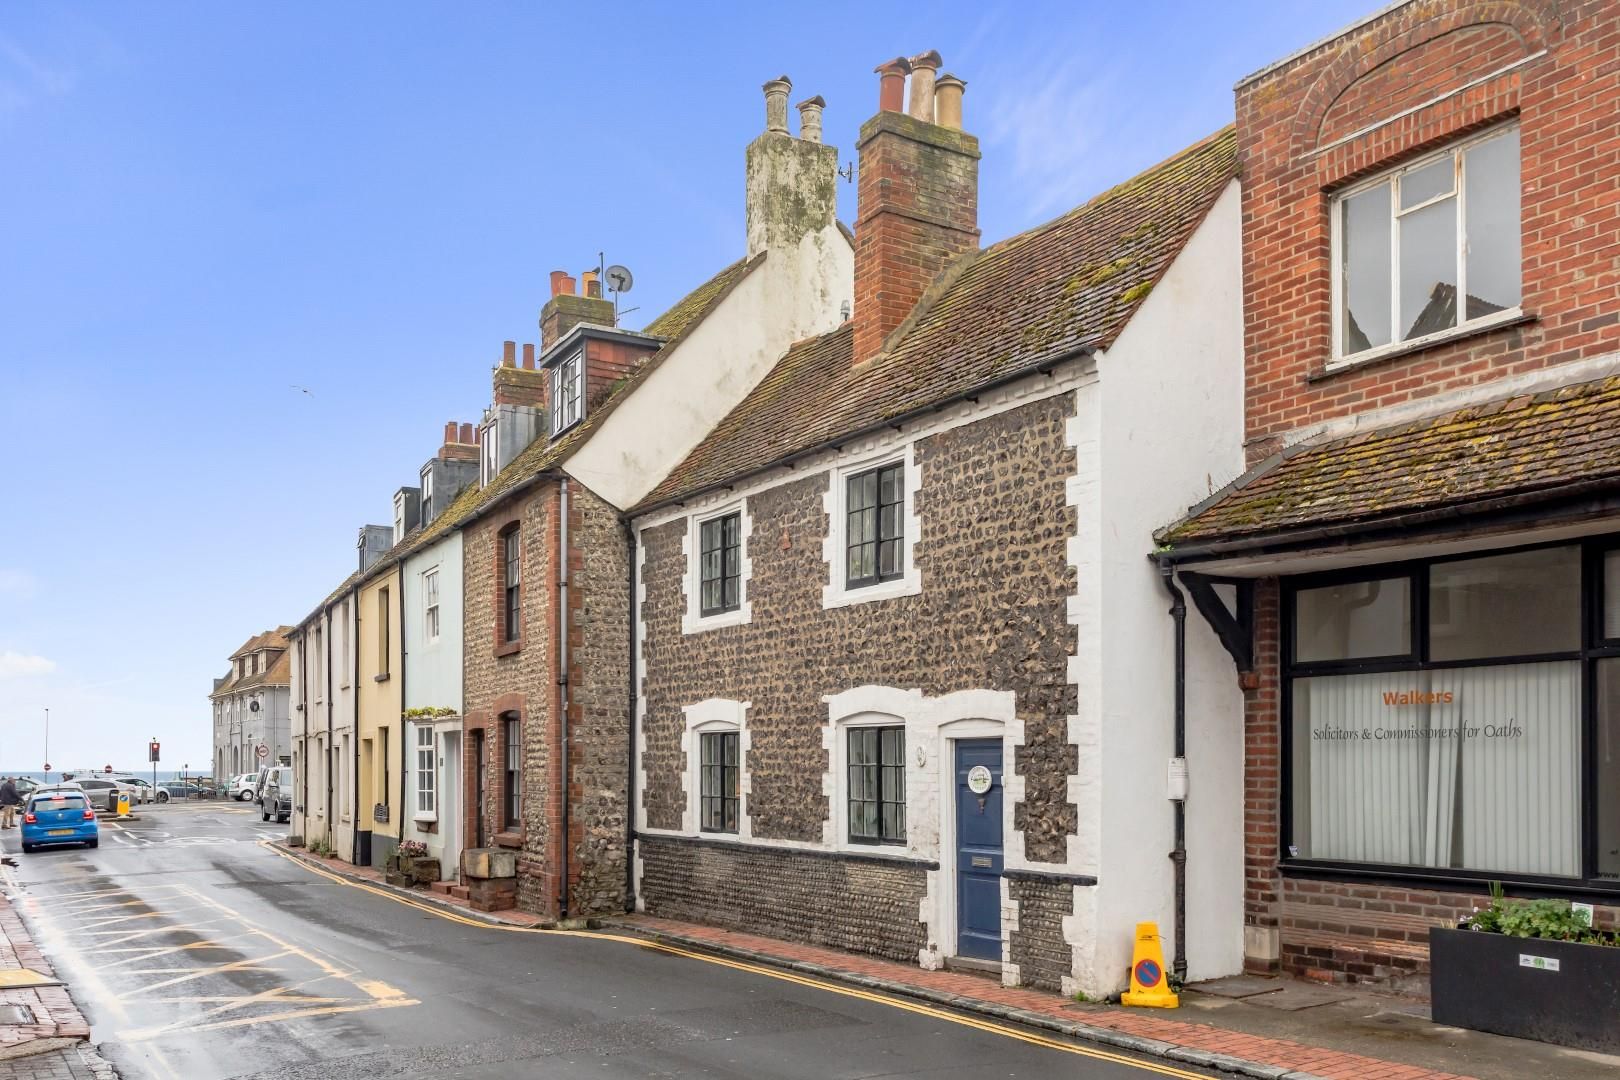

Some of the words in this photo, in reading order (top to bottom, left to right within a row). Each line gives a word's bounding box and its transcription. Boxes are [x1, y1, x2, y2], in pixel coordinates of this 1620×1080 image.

[1383, 690, 1453, 705] Walkers
[1313, 723, 1359, 740] Solicitors
[1361, 728, 1372, 740] &
[1374, 724, 1459, 740] Commissioners
[1463, 719, 1480, 742] for
[1484, 718, 1522, 739] Oaths
